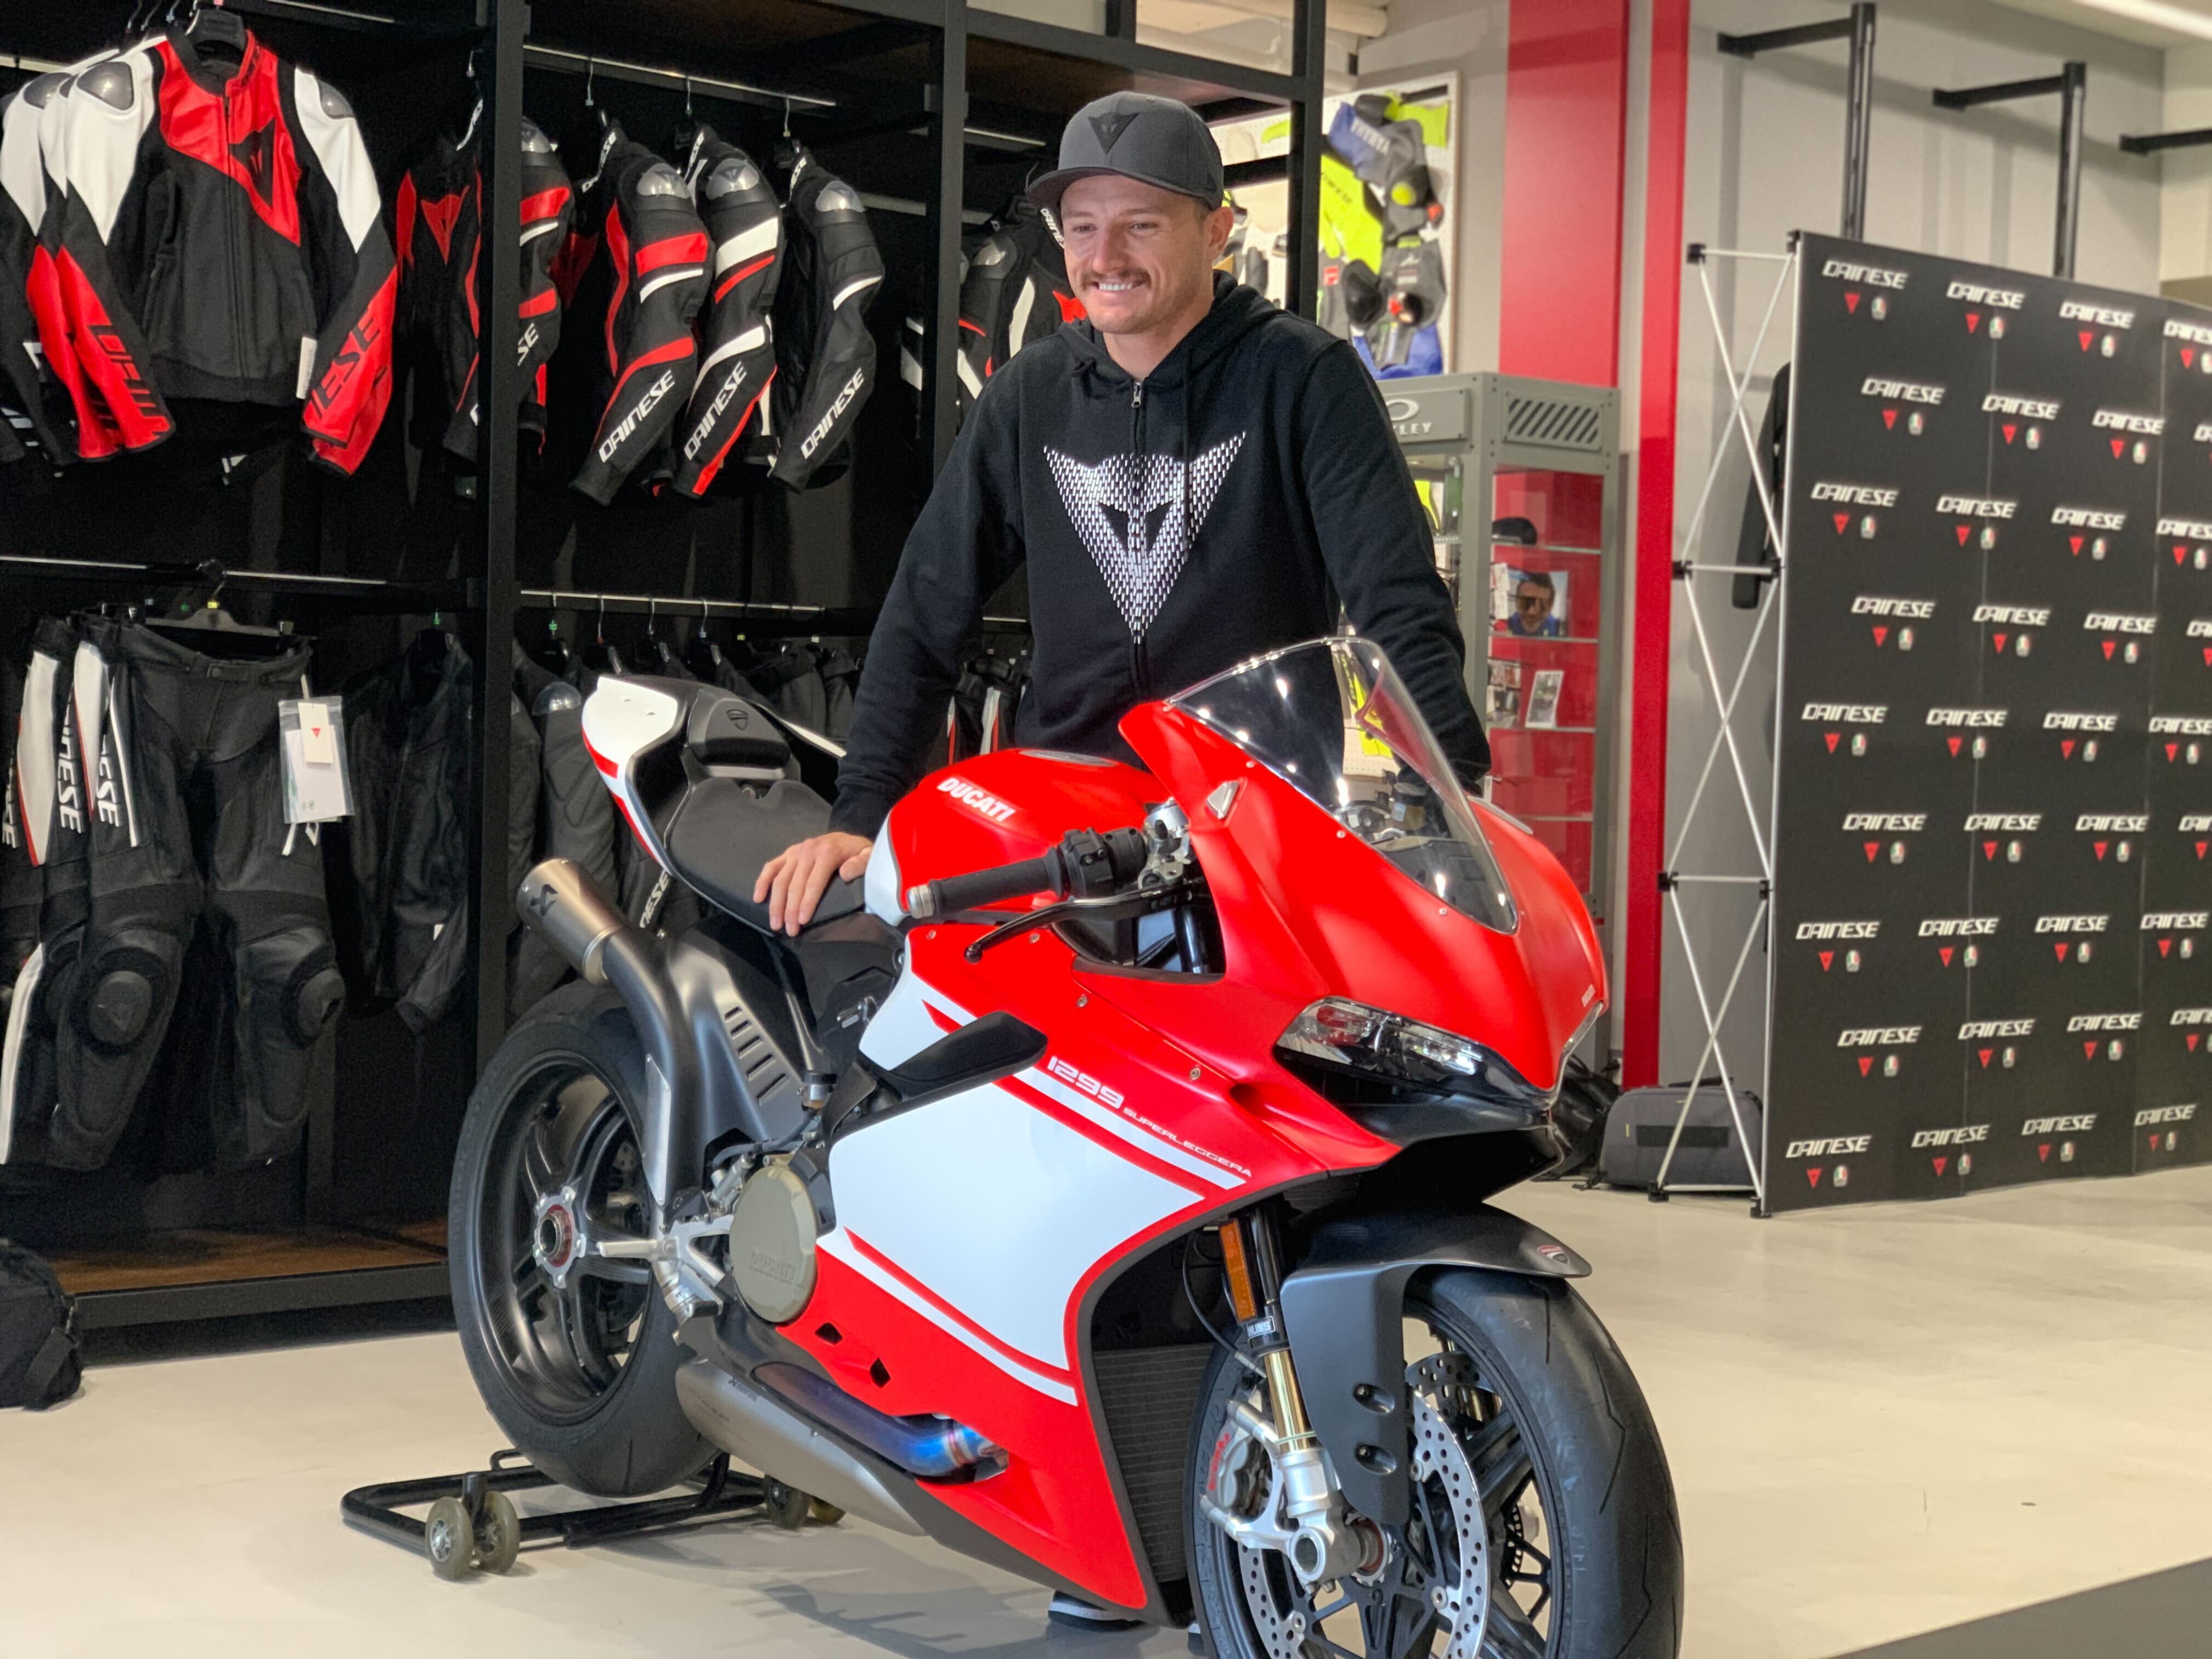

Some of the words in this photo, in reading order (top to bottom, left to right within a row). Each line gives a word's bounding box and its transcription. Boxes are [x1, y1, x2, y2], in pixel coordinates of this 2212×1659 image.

[1822, 260, 1908, 290] DAINESE
[1946, 281, 2025, 309] DAINESE
[2059, 301, 2134, 328] DAINESE
[2163, 320, 2212, 345] DAINE
[1861, 378, 1945, 405] DAINESE
[599, 369, 675, 463] DAINESE
[684, 361, 747, 461] DAINESE
[800, 367, 864, 460] DAINESE
[1982, 393, 2060, 420] DAINESE
[1393, 422, 1432, 435] LEY
[2092, 409, 2165, 435] DAINESE
[1811, 483, 1899, 507] DAINESE
[1936, 496, 2017, 519] DAINESE
[2051, 507, 2126, 531] DAINESE
[1851, 597, 1936, 618] DAINESE
[1973, 605, 2051, 626] DAINESE
[2084, 614, 2158, 634] DAINESE
[1802, 703, 1888, 723] DAINESE
[1926, 709, 2008, 727] DAINESE
[2043, 713, 2118, 731] DAINESE
[936, 777, 1016, 822] DUCATI
[1843, 814, 1927, 831] DAINESE
[1964, 814, 2041, 831] DAINESE
[2075, 815, 2149, 832] DAINESE
[1796, 922, 1880, 940] DAINESE
[1918, 918, 1999, 936] DAINESE
[2035, 916, 2109, 933] DAINESE
[2140, 913, 2209, 929] DAINESE
[1958, 1019, 2035, 1040] DAINESE
[2067, 1013, 2142, 1032] DAINESE
[1837, 1026, 1922, 1047] DAINESE
[1047, 1056, 1124, 1109] 1299
[1122, 1106, 1252, 1177] SUPERLEGGERA
[2022, 1115, 2096, 1136] DAINESE
[2135, 1104, 2196, 1126] DAINESE
[1786, 1136, 1872, 1158] DAINESE
[1912, 1125, 1990, 1148] DAINESE
